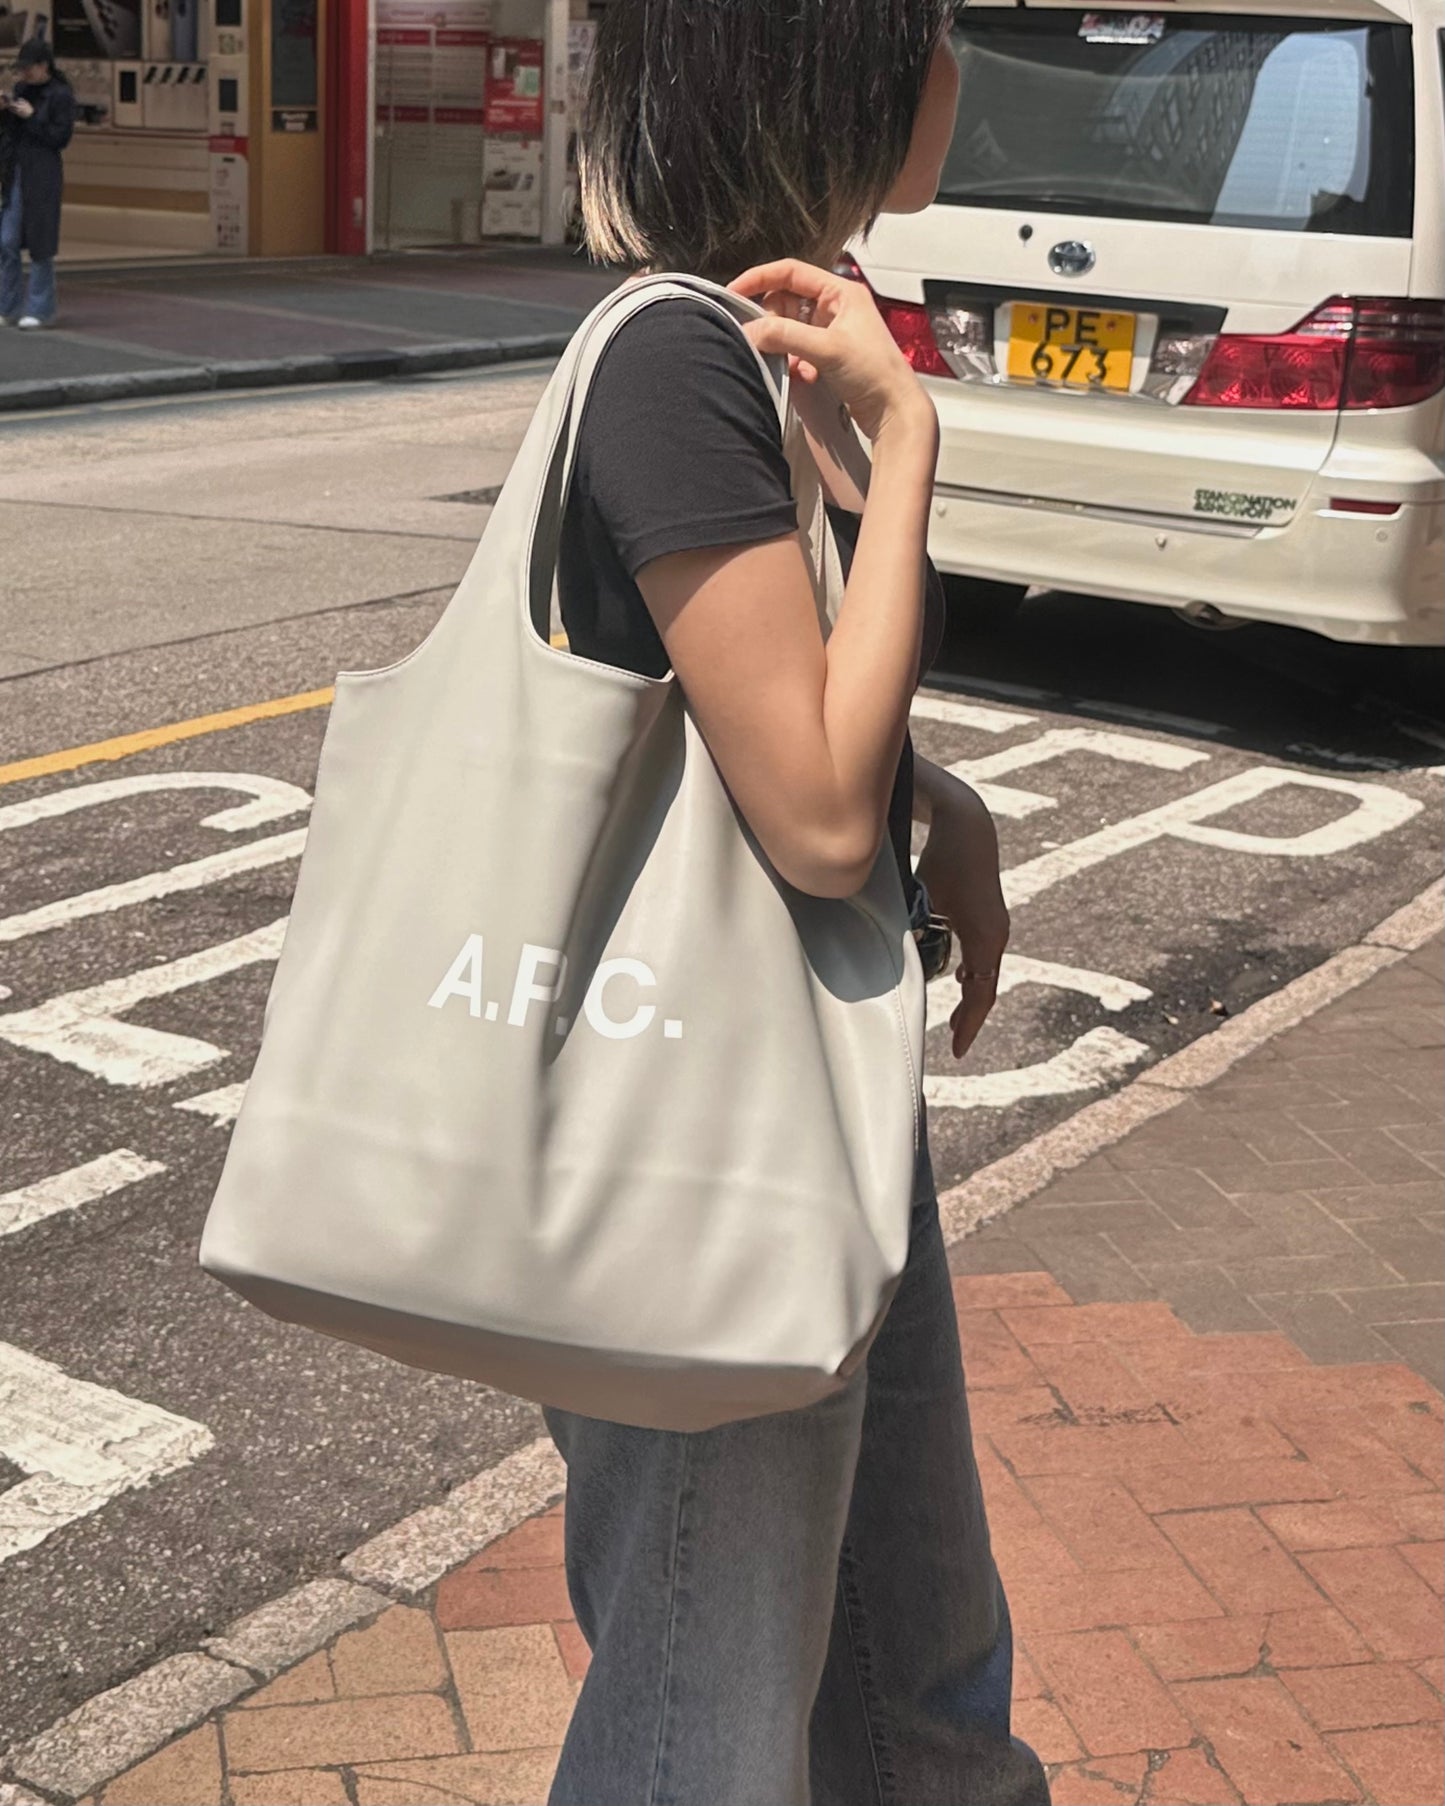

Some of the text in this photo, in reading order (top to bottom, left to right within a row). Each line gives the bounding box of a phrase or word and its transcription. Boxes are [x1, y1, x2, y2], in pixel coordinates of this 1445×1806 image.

[1044, 307, 1101, 346] PE
[1030, 341, 1109, 385] 673
[426, 932, 683, 1040] A.P.C.
